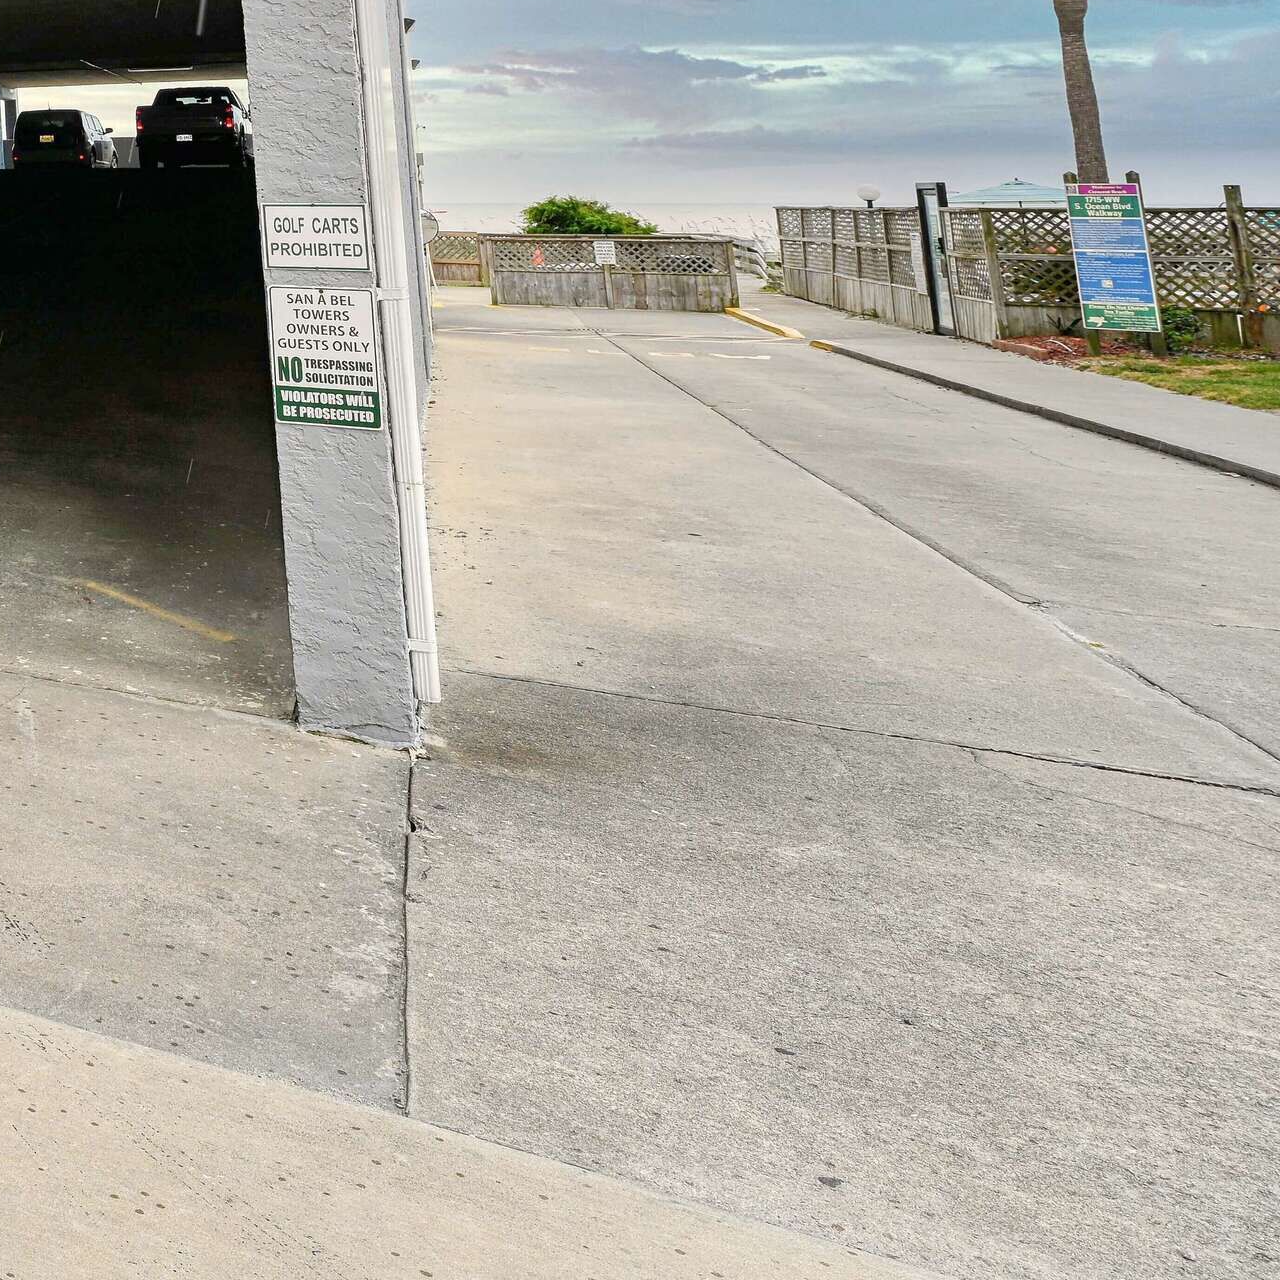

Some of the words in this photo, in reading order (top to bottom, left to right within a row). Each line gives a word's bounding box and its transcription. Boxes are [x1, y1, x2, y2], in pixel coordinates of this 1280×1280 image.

[274, 217, 304, 233] GOLF
[312, 217, 359, 234] CARTS
[270, 242, 363, 257] PROHIBITED
[286, 294, 313, 304] SAN
[317, 294, 327, 305] A
[331, 295, 355, 306] BEL
[293, 309, 350, 321] TOWERS
[286, 323, 345, 336] OWNERS
[349, 326, 359, 337] &
[278, 338, 329, 350] GUESTS
[332, 341, 370, 352] ONLY
[278, 356, 303, 382] NO
[304, 358, 373, 372] TRESPASSING
[306, 372, 373, 386] SOLICITATION
[281, 390, 344, 405] VIOLATORS
[346, 394, 374, 407] WILL
[283, 405, 297, 417] BE
[300, 406, 374, 423] PROSECUTED
